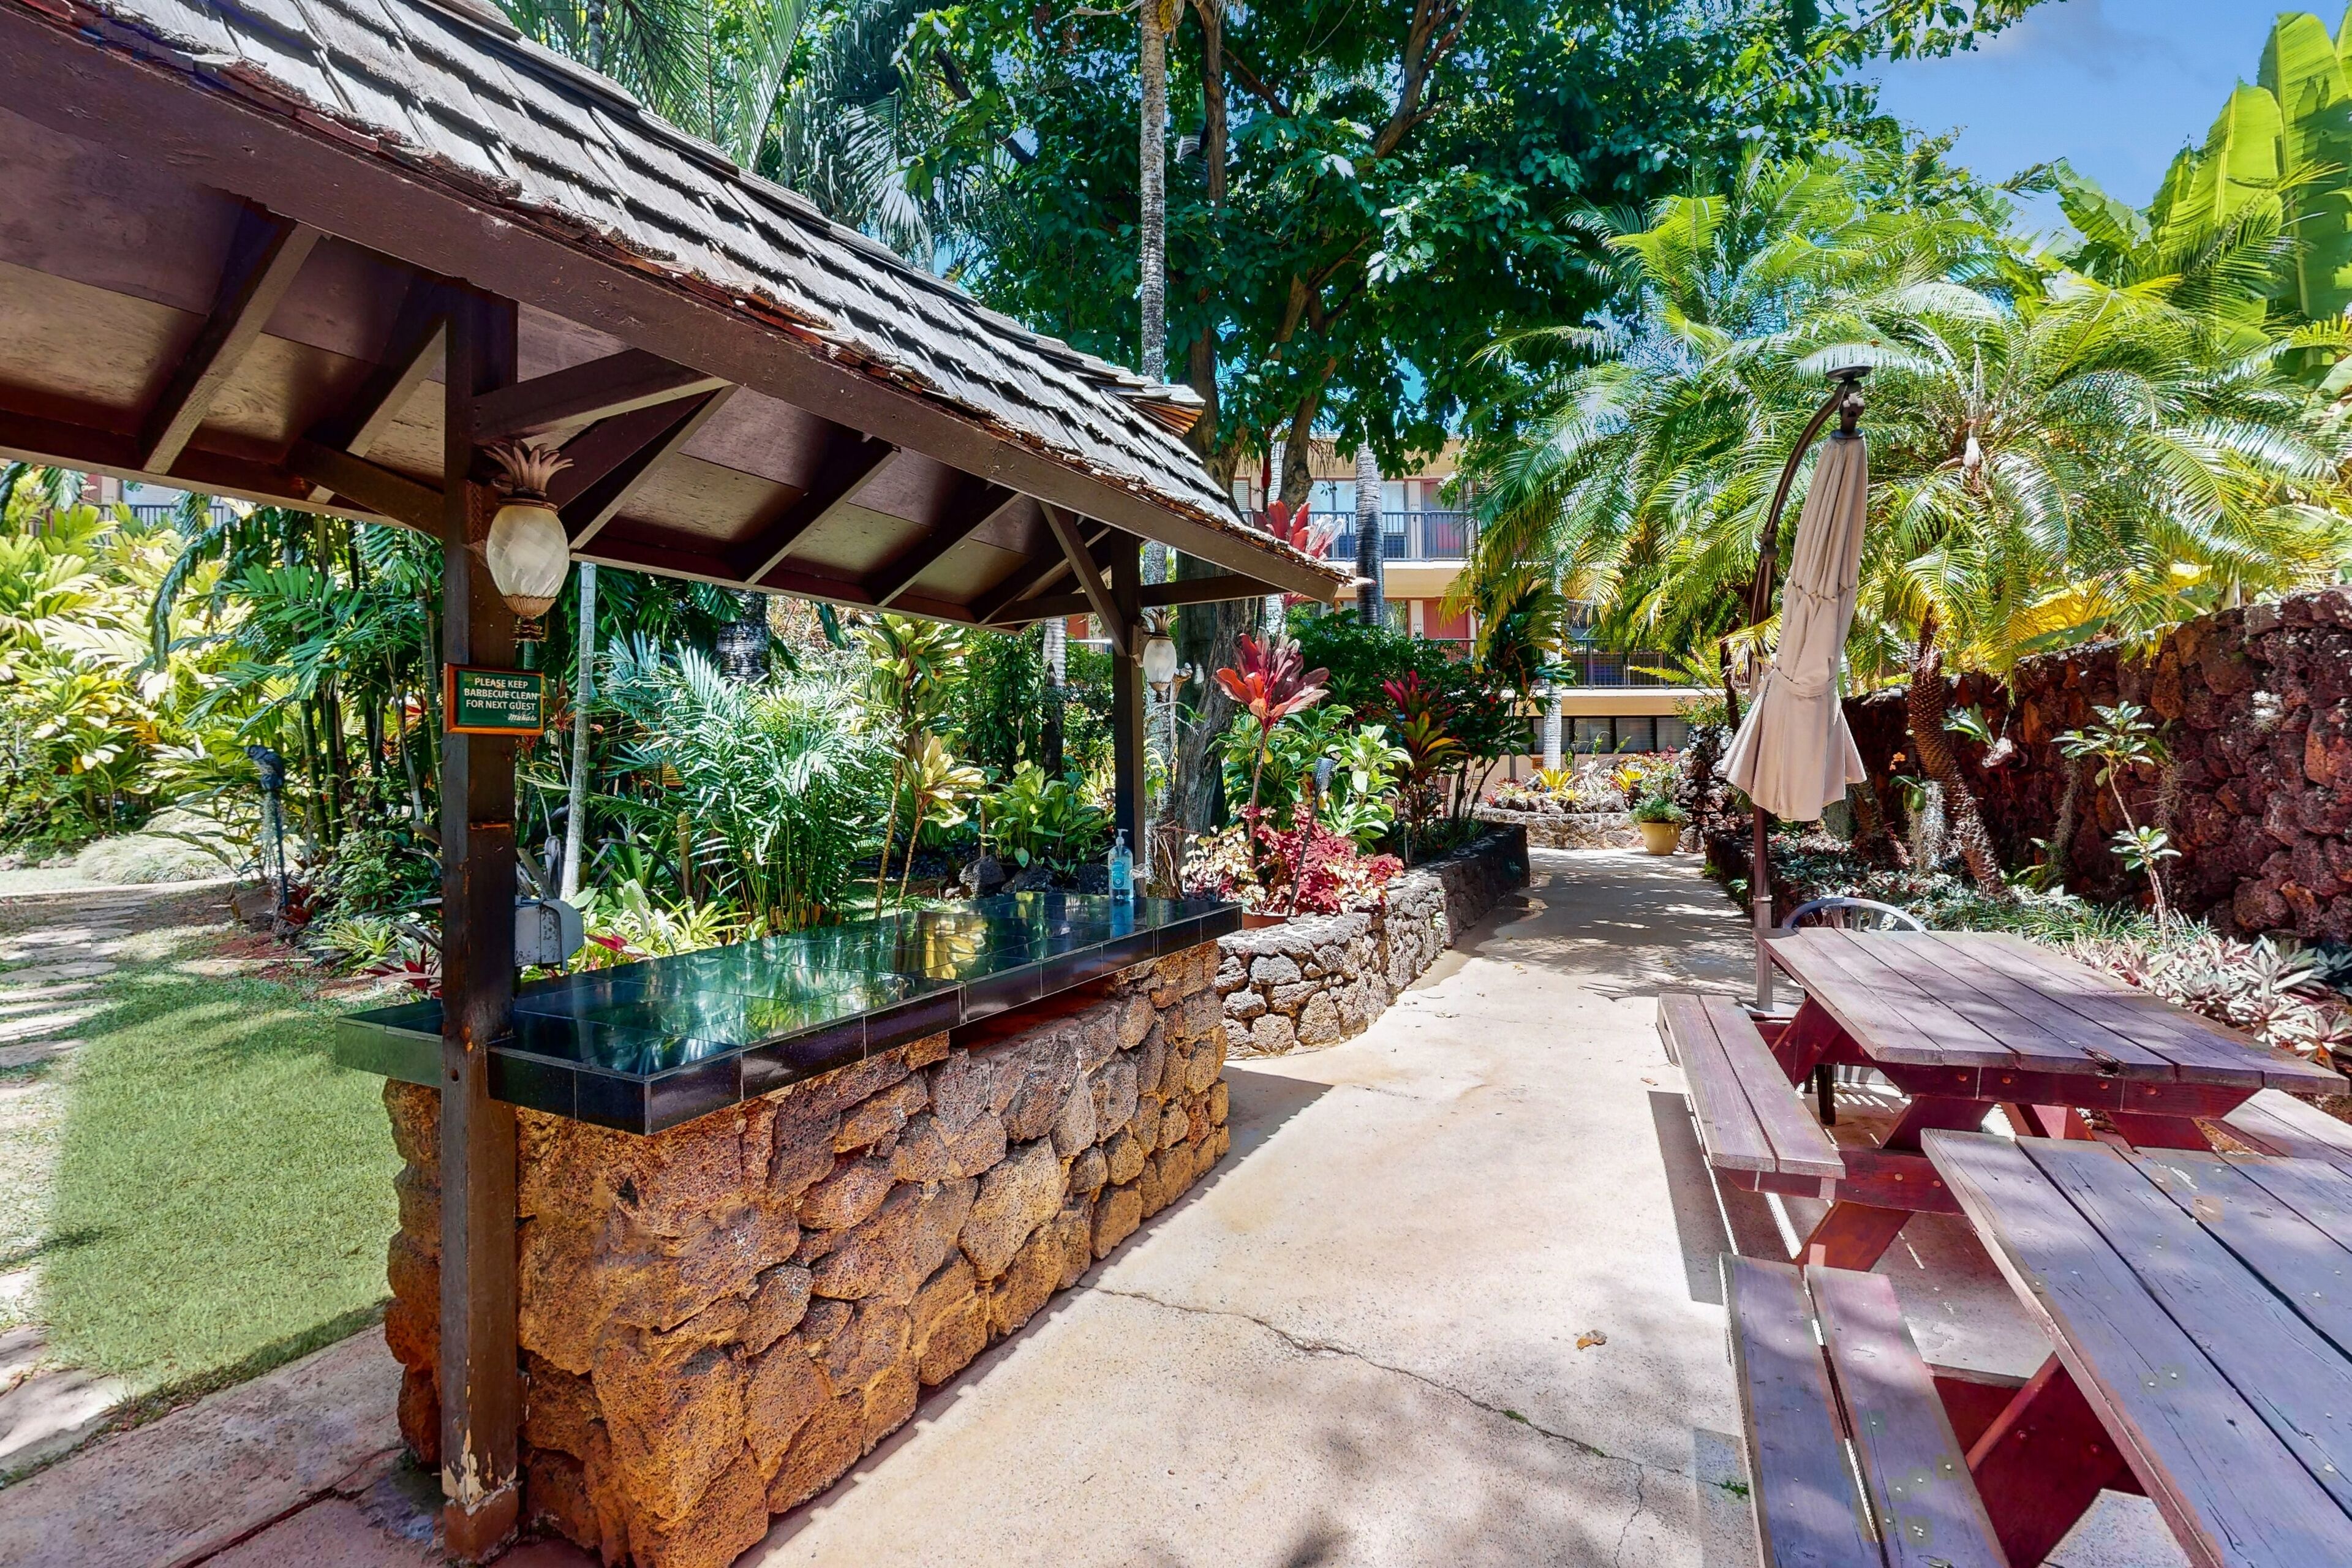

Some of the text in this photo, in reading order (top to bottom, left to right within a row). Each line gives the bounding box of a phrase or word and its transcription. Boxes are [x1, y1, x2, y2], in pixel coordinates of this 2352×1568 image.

[475, 677, 528, 689] PLEASE KEEP
[464, 688, 538, 700] BARBECUE CLEAN
[466, 699, 536, 710] FOR NEXT GUEST
